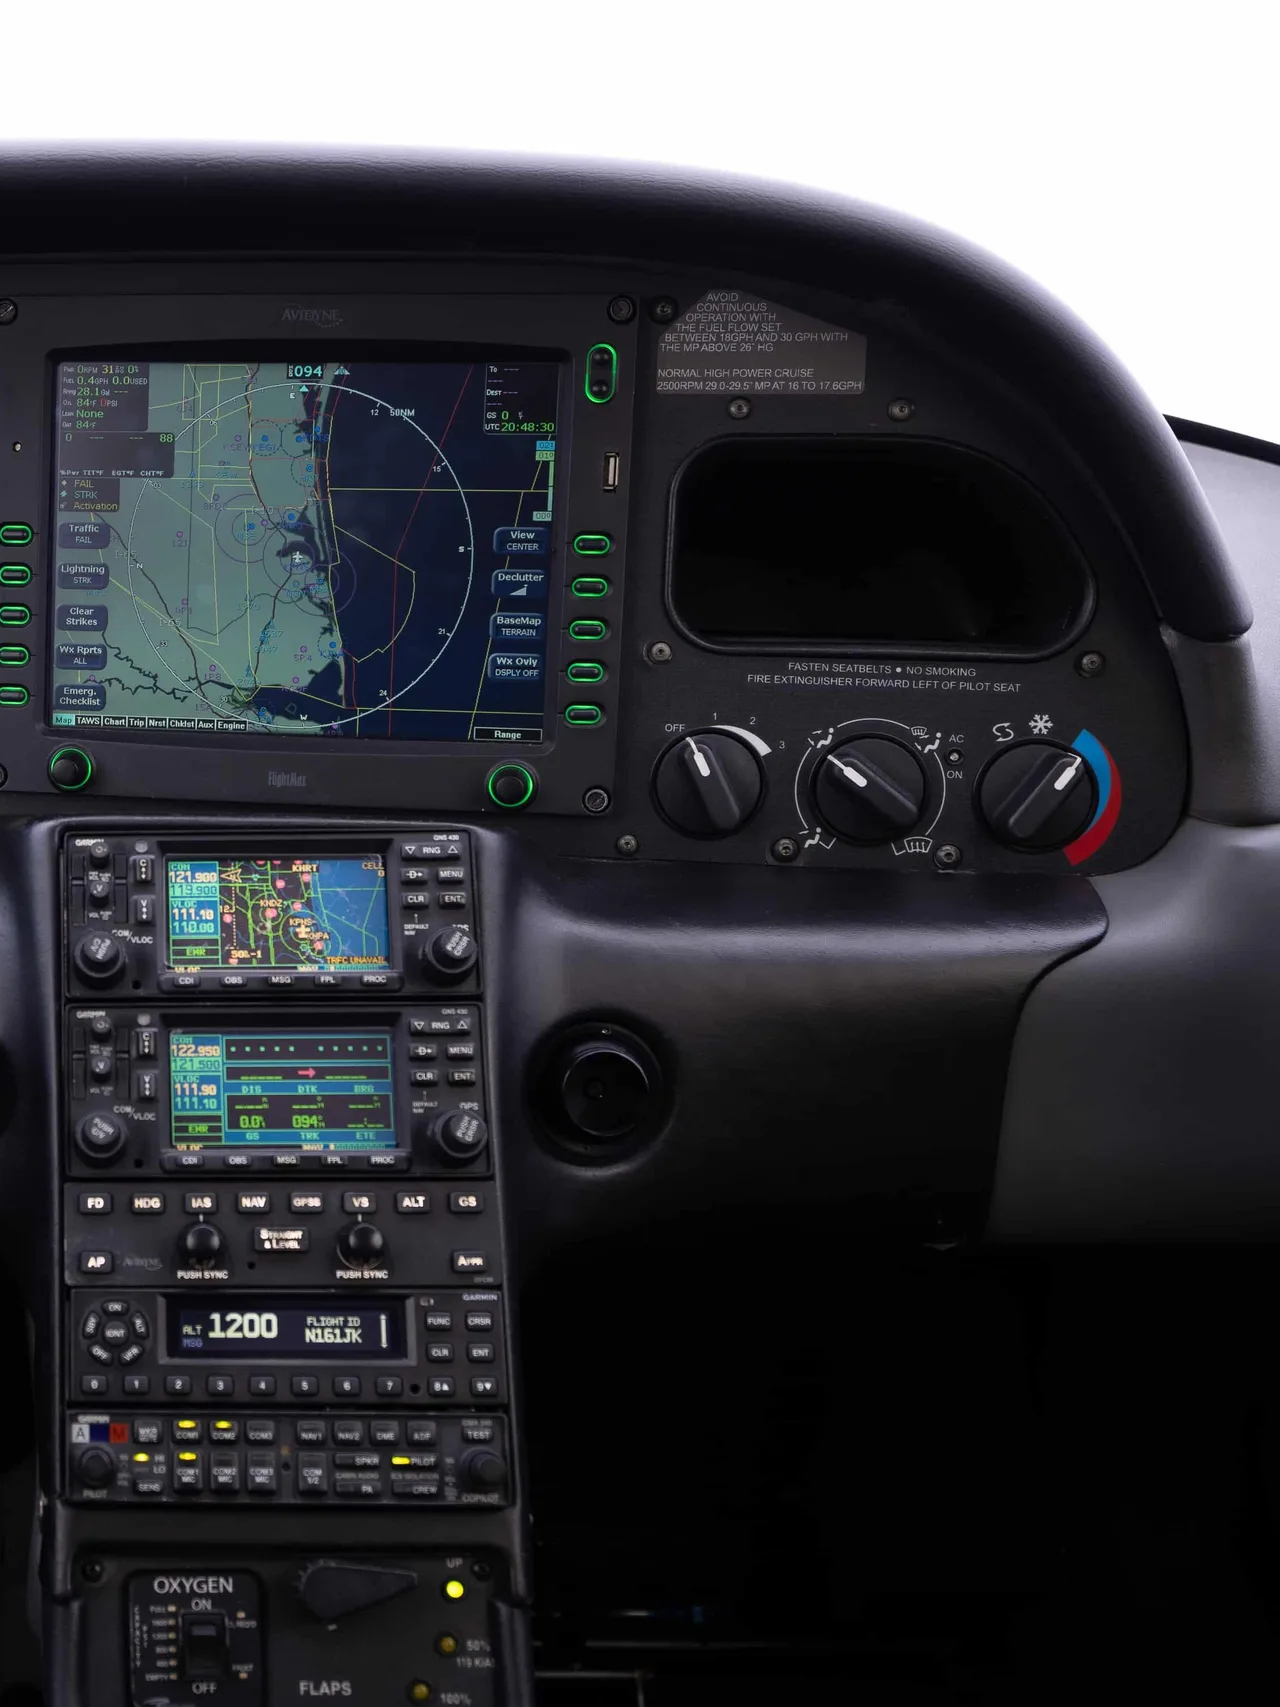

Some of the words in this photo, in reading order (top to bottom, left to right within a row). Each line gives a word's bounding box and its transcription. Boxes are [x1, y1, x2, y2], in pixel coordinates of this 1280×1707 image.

[706, 293, 739, 301] AVOID
[697, 303, 767, 312] CONTINUOUS
[686, 313, 749, 322] OPERATION
[750, 313, 776, 321] WITH
[676, 324, 695, 332] THE
[700, 323, 725, 332] FUEL
[729, 323, 758, 332] FLOW
[761, 323, 782, 332] SET
[665, 333, 716, 342] BETWEEN
[721, 333, 754, 342] 18GPH
[755, 333, 777, 341] AND
[780, 333, 792, 341] 30
[795, 333, 818, 341] GPH
[821, 333, 848, 341] WITH
[660, 344, 680, 352] THE
[683, 344, 700, 352] MP
[701, 343, 736, 352] ABOVE
[757, 343, 774, 352] HG
[294, 366, 322, 377] 094
[658, 369, 700, 377] NORMAL
[704, 369, 730, 377] HIGH
[733, 369, 771, 378] POWER
[774, 369, 814, 378] CRUISE
[657, 382, 703, 390] 2500RPM
[755, 382, 771, 390] MP
[771, 381, 784, 390] AT
[788, 382, 799, 390] 16
[802, 382, 816, 390] TO
[501, 422, 555, 432] 20:48:30
[69, 524, 99, 533] Traffic
[510, 530, 535, 539] View
[506, 542, 539, 551] CENTER
[61, 565, 104, 575] Lightning
[498, 573, 544, 582] Declutter
[70, 607, 94, 615] Clear
[66, 617, 97, 626] Strikes
[497, 616, 542, 626] BaseMap
[500, 628, 537, 637] TERRAIN
[788, 662, 829, 672] FASTEN
[832, 664, 891, 674] SEATBELTS
[907, 667, 922, 675] NO
[925, 667, 977, 677] SMOKING
[748, 675, 771, 684] FIRE
[774, 675, 853, 687] EXTINGUISHER
[856, 679, 910, 689] FORWARD
[912, 681, 938, 690] LEFT
[941, 682, 957, 690] OF
[959, 682, 990, 692] PILOT
[993, 683, 1021, 693] SEAT
[63, 687, 96, 697] Emerg.
[59, 697, 101, 706] Checklist
[712, 712, 718, 720] 1
[749, 716, 756, 725] 2
[77, 716, 100, 724] TAWS
[104, 718, 125, 726] Chart
[217, 721, 246, 730] Engine
[664, 723, 686, 732] OFF
[949, 734, 965, 743] AC
[779, 740, 785, 749] 3
[946, 770, 963, 779] ON
[422, 846, 441, 854] RNG
[440, 870, 463, 878] MENU
[407, 895, 424, 903] CLR
[444, 895, 461, 903] ENT
[87, 1197, 104, 1209] FD
[134, 1197, 161, 1209] HDG
[191, 1197, 212, 1208] IAS
[241, 1196, 266, 1208] NAV
[293, 1197, 321, 1207] GPSS
[352, 1197, 369, 1207] VS
[402, 1196, 426, 1208] ALT
[458, 1196, 477, 1207] GS
[87, 1256, 106, 1268] AP
[177, 1270, 202, 1280] PUSH
[204, 1270, 229, 1280] SYNC
[462, 1293, 497, 1301] GARMIN
[208, 1312, 278, 1339] 1200
[306, 1316, 344, 1328] FLIGHT
[347, 1316, 360, 1327] ID
[305, 1328, 362, 1344] N161JK
[446, 1557, 463, 1568] UP
[153, 1576, 233, 1594] OXYGEN
[190, 1598, 212, 1611] ON
[299, 1680, 352, 1696] FLAPS
